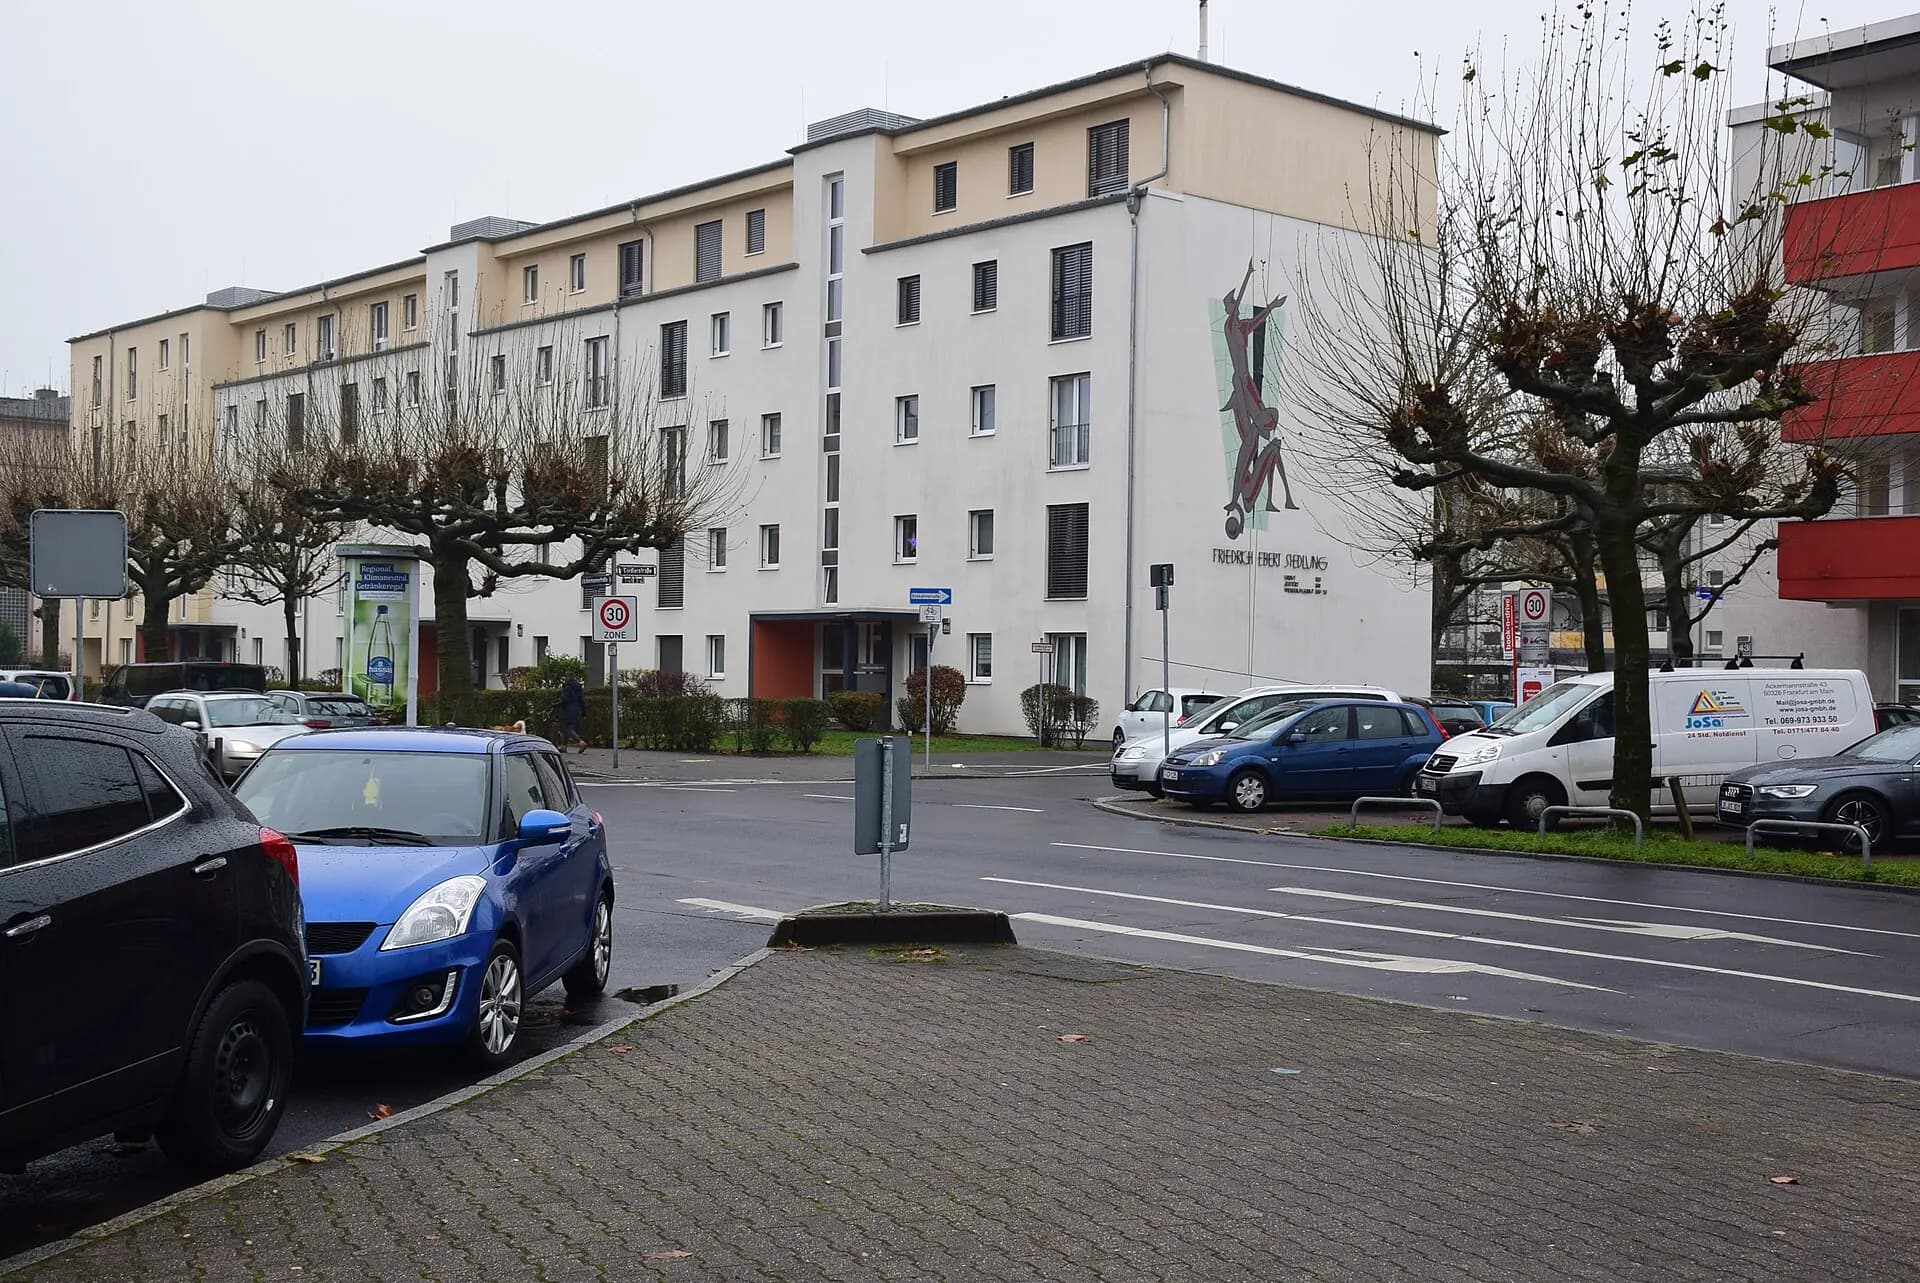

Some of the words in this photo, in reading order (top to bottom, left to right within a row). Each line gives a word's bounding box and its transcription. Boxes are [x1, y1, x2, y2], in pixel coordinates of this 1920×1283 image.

[1212, 548, 1254, 565] FRIEDRICH
[1258, 551, 1281, 567] EBERT
[1283, 553, 1329, 571] SIEDLUNG
[1528, 599, 1541, 613] 30
[606, 607, 624, 622] 30
[603, 631, 626, 640] ZONE
[1685, 717, 1721, 729] JoSa
[1765, 717, 1778, 725] Tel.
[1780, 716, 1811, 724] 069-973
